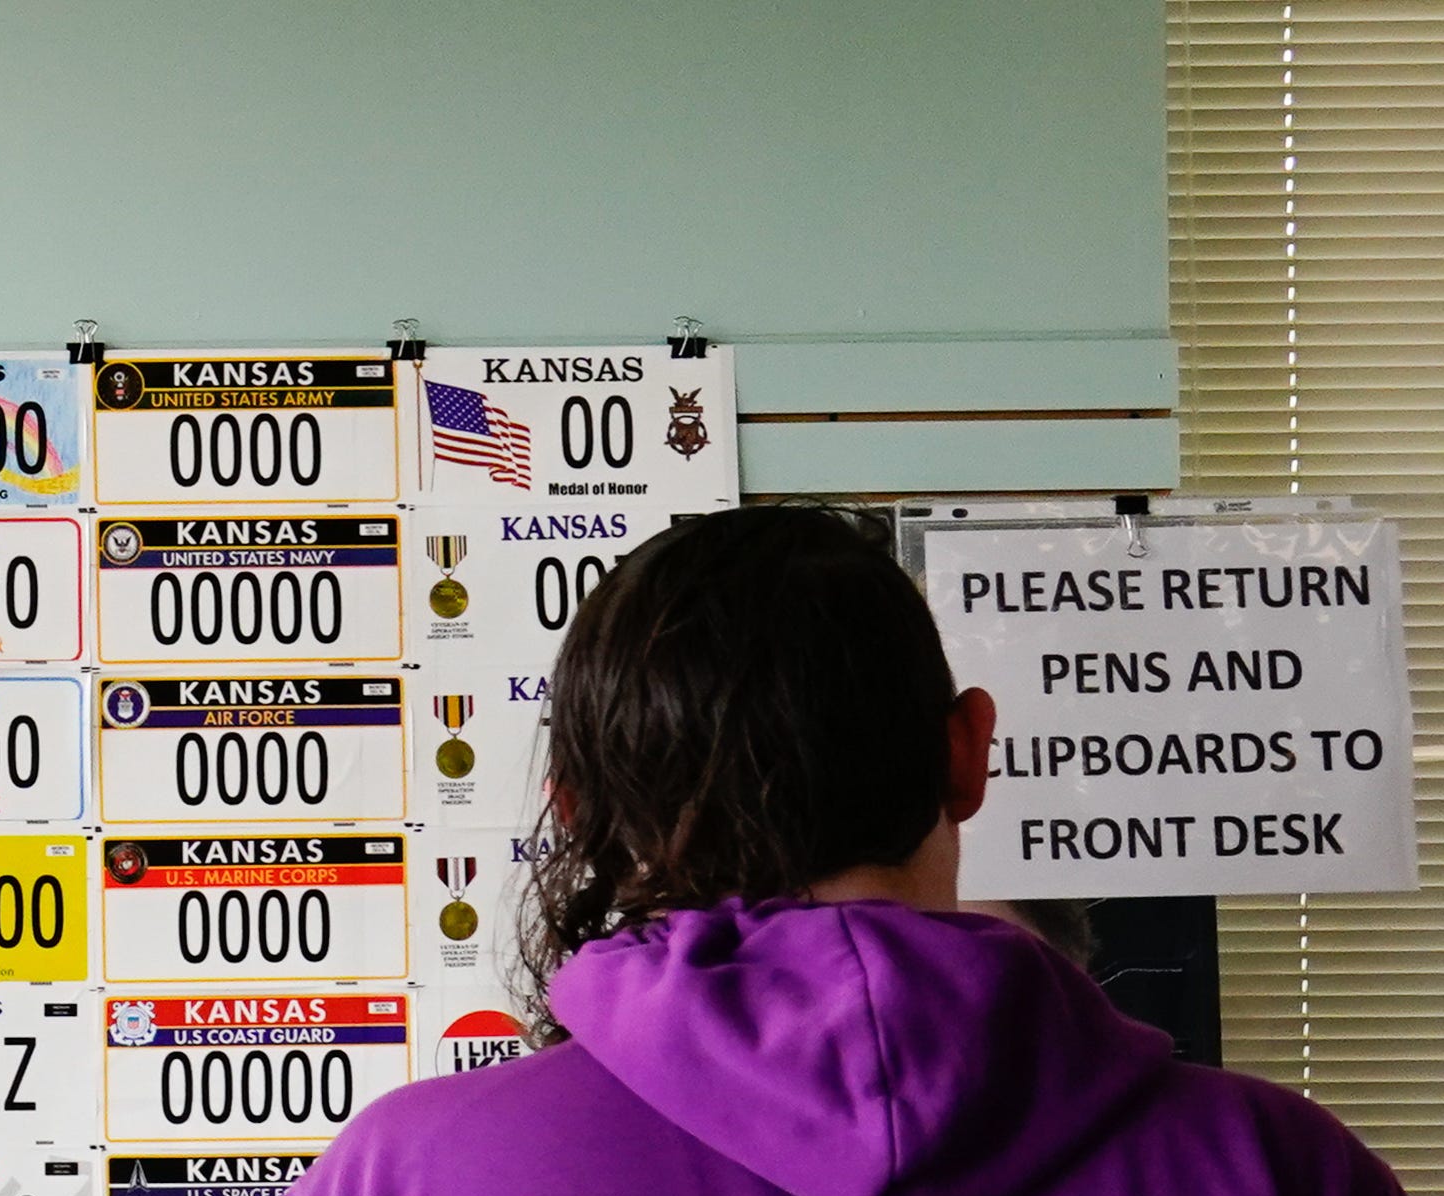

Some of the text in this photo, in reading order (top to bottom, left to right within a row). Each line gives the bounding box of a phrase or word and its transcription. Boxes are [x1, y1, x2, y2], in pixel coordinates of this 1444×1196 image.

[173, 363, 315, 386] KANSAS
[482, 357, 644, 383] KANSAS
[151, 391, 336, 407] UNITED STATES ARMY
[561, 395, 634, 469] 00
[170, 413, 321, 487] 0000
[549, 483, 648, 495] Medal of Honor
[176, 521, 318, 545] KANSAS
[162, 551, 336, 566] UNITED STATES NAVY
[962, 565, 1370, 613] PLEASE RETURN
[151, 570, 342, 645] 00000
[1042, 650, 1302, 694] PENS AND
[203, 711, 295, 726] AIR FORCE
[1311, 729, 1383, 770] TO
[176, 731, 328, 806] 0000
[1020, 813, 1344, 860] FRONT DESK
[182, 839, 324, 864] KANSAS
[166, 869, 338, 885] U.S. MARINE CORPS
[178, 889, 330, 964] 0000
[174, 1029, 336, 1045] U.S COAST GUARD
[454, 1040, 520, 1057] I LIKE
[161, 1050, 352, 1125] 00000
